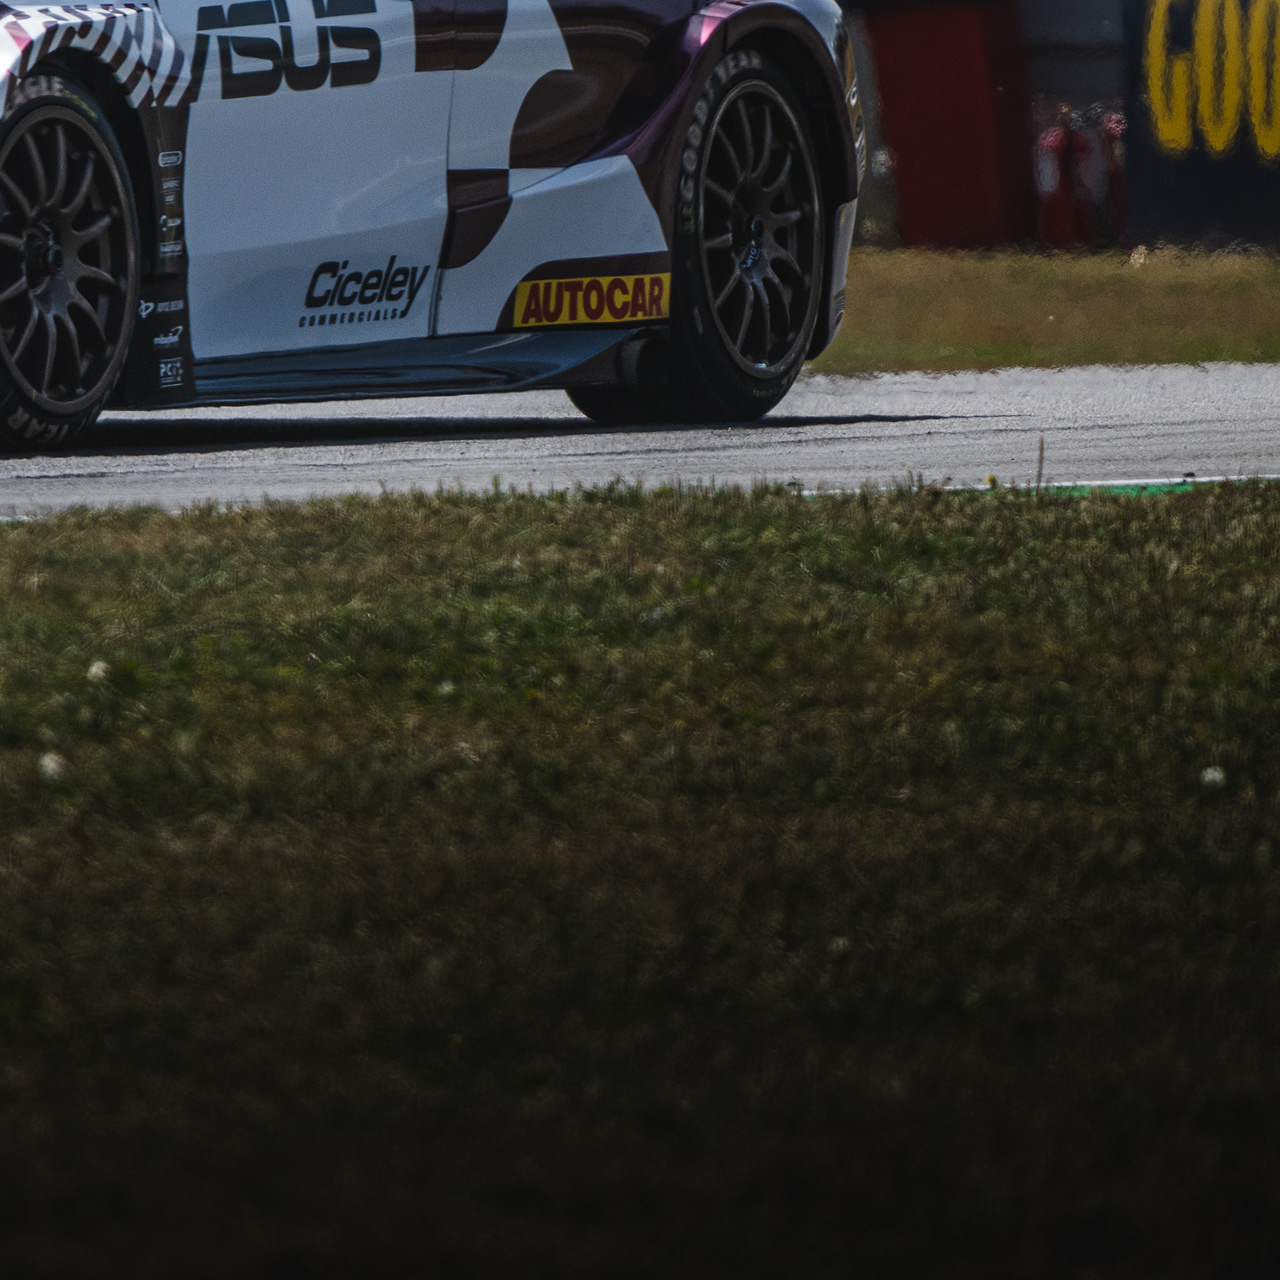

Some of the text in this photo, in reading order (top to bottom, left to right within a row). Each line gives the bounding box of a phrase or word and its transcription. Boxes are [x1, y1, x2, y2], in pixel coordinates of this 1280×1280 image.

[305, 255, 430, 319] Ciceley
[521, 276, 664, 325] AUTOCAR
[298, 308, 399, 328] COMMERCIALS
